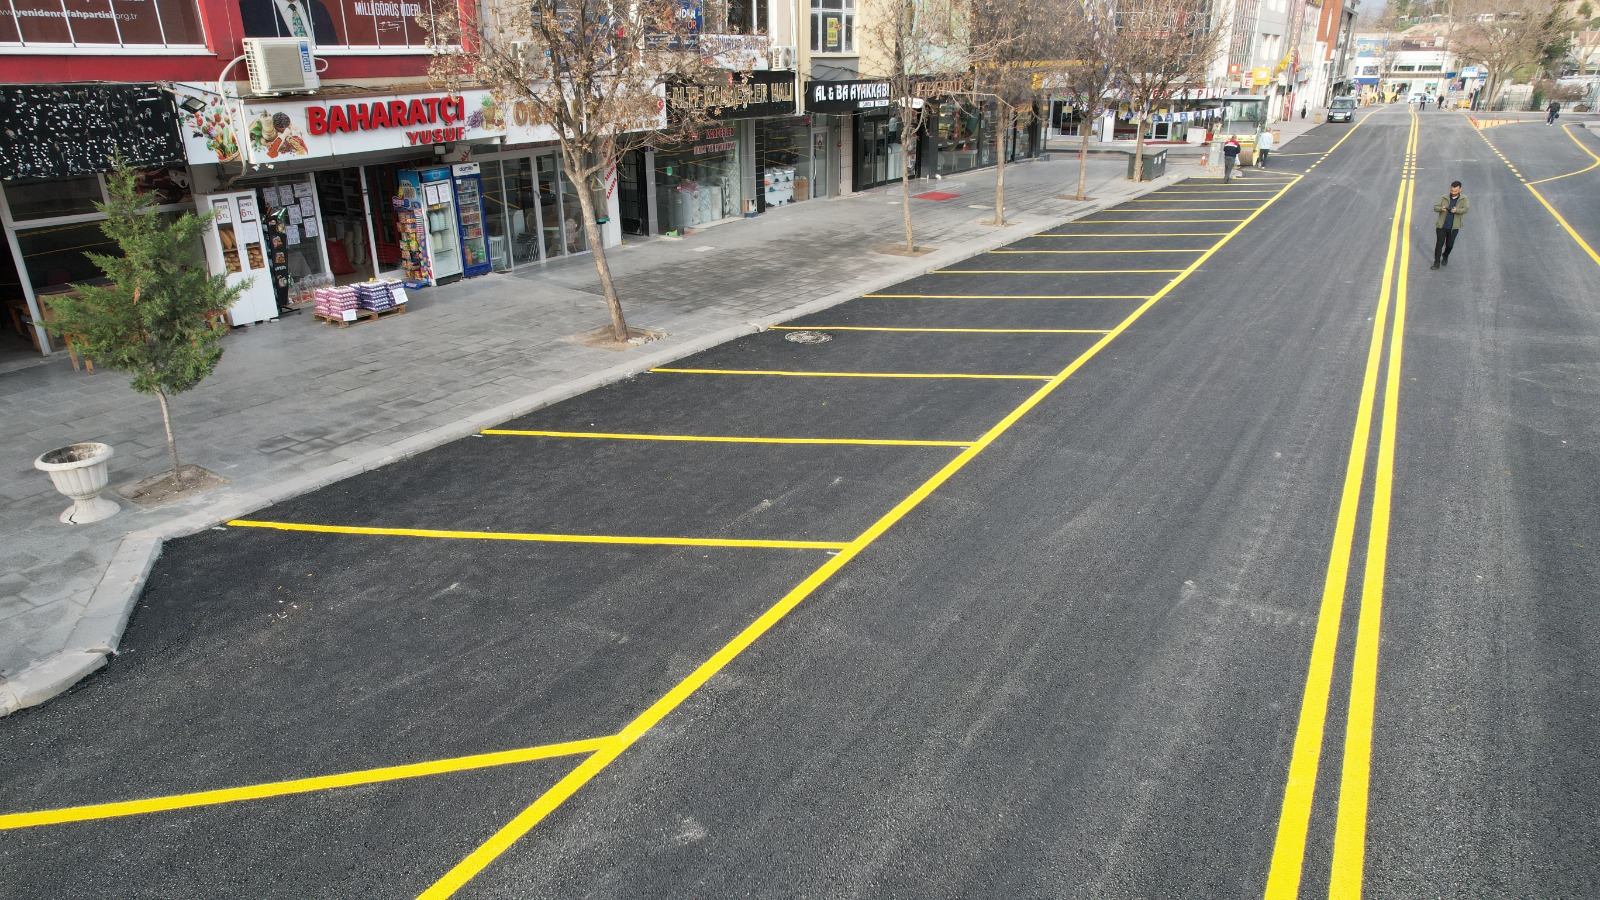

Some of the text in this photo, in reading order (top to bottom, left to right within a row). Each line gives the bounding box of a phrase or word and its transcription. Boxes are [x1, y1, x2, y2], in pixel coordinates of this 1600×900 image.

[375, 1, 399, 19] GÖRÜŞ
[771, 82, 794, 103] HALI
[815, 83, 890, 102] AL & BA AYAKKABI
[306, 96, 465, 135] BAHARATÇI
[406, 126, 465, 146] YUSUF
